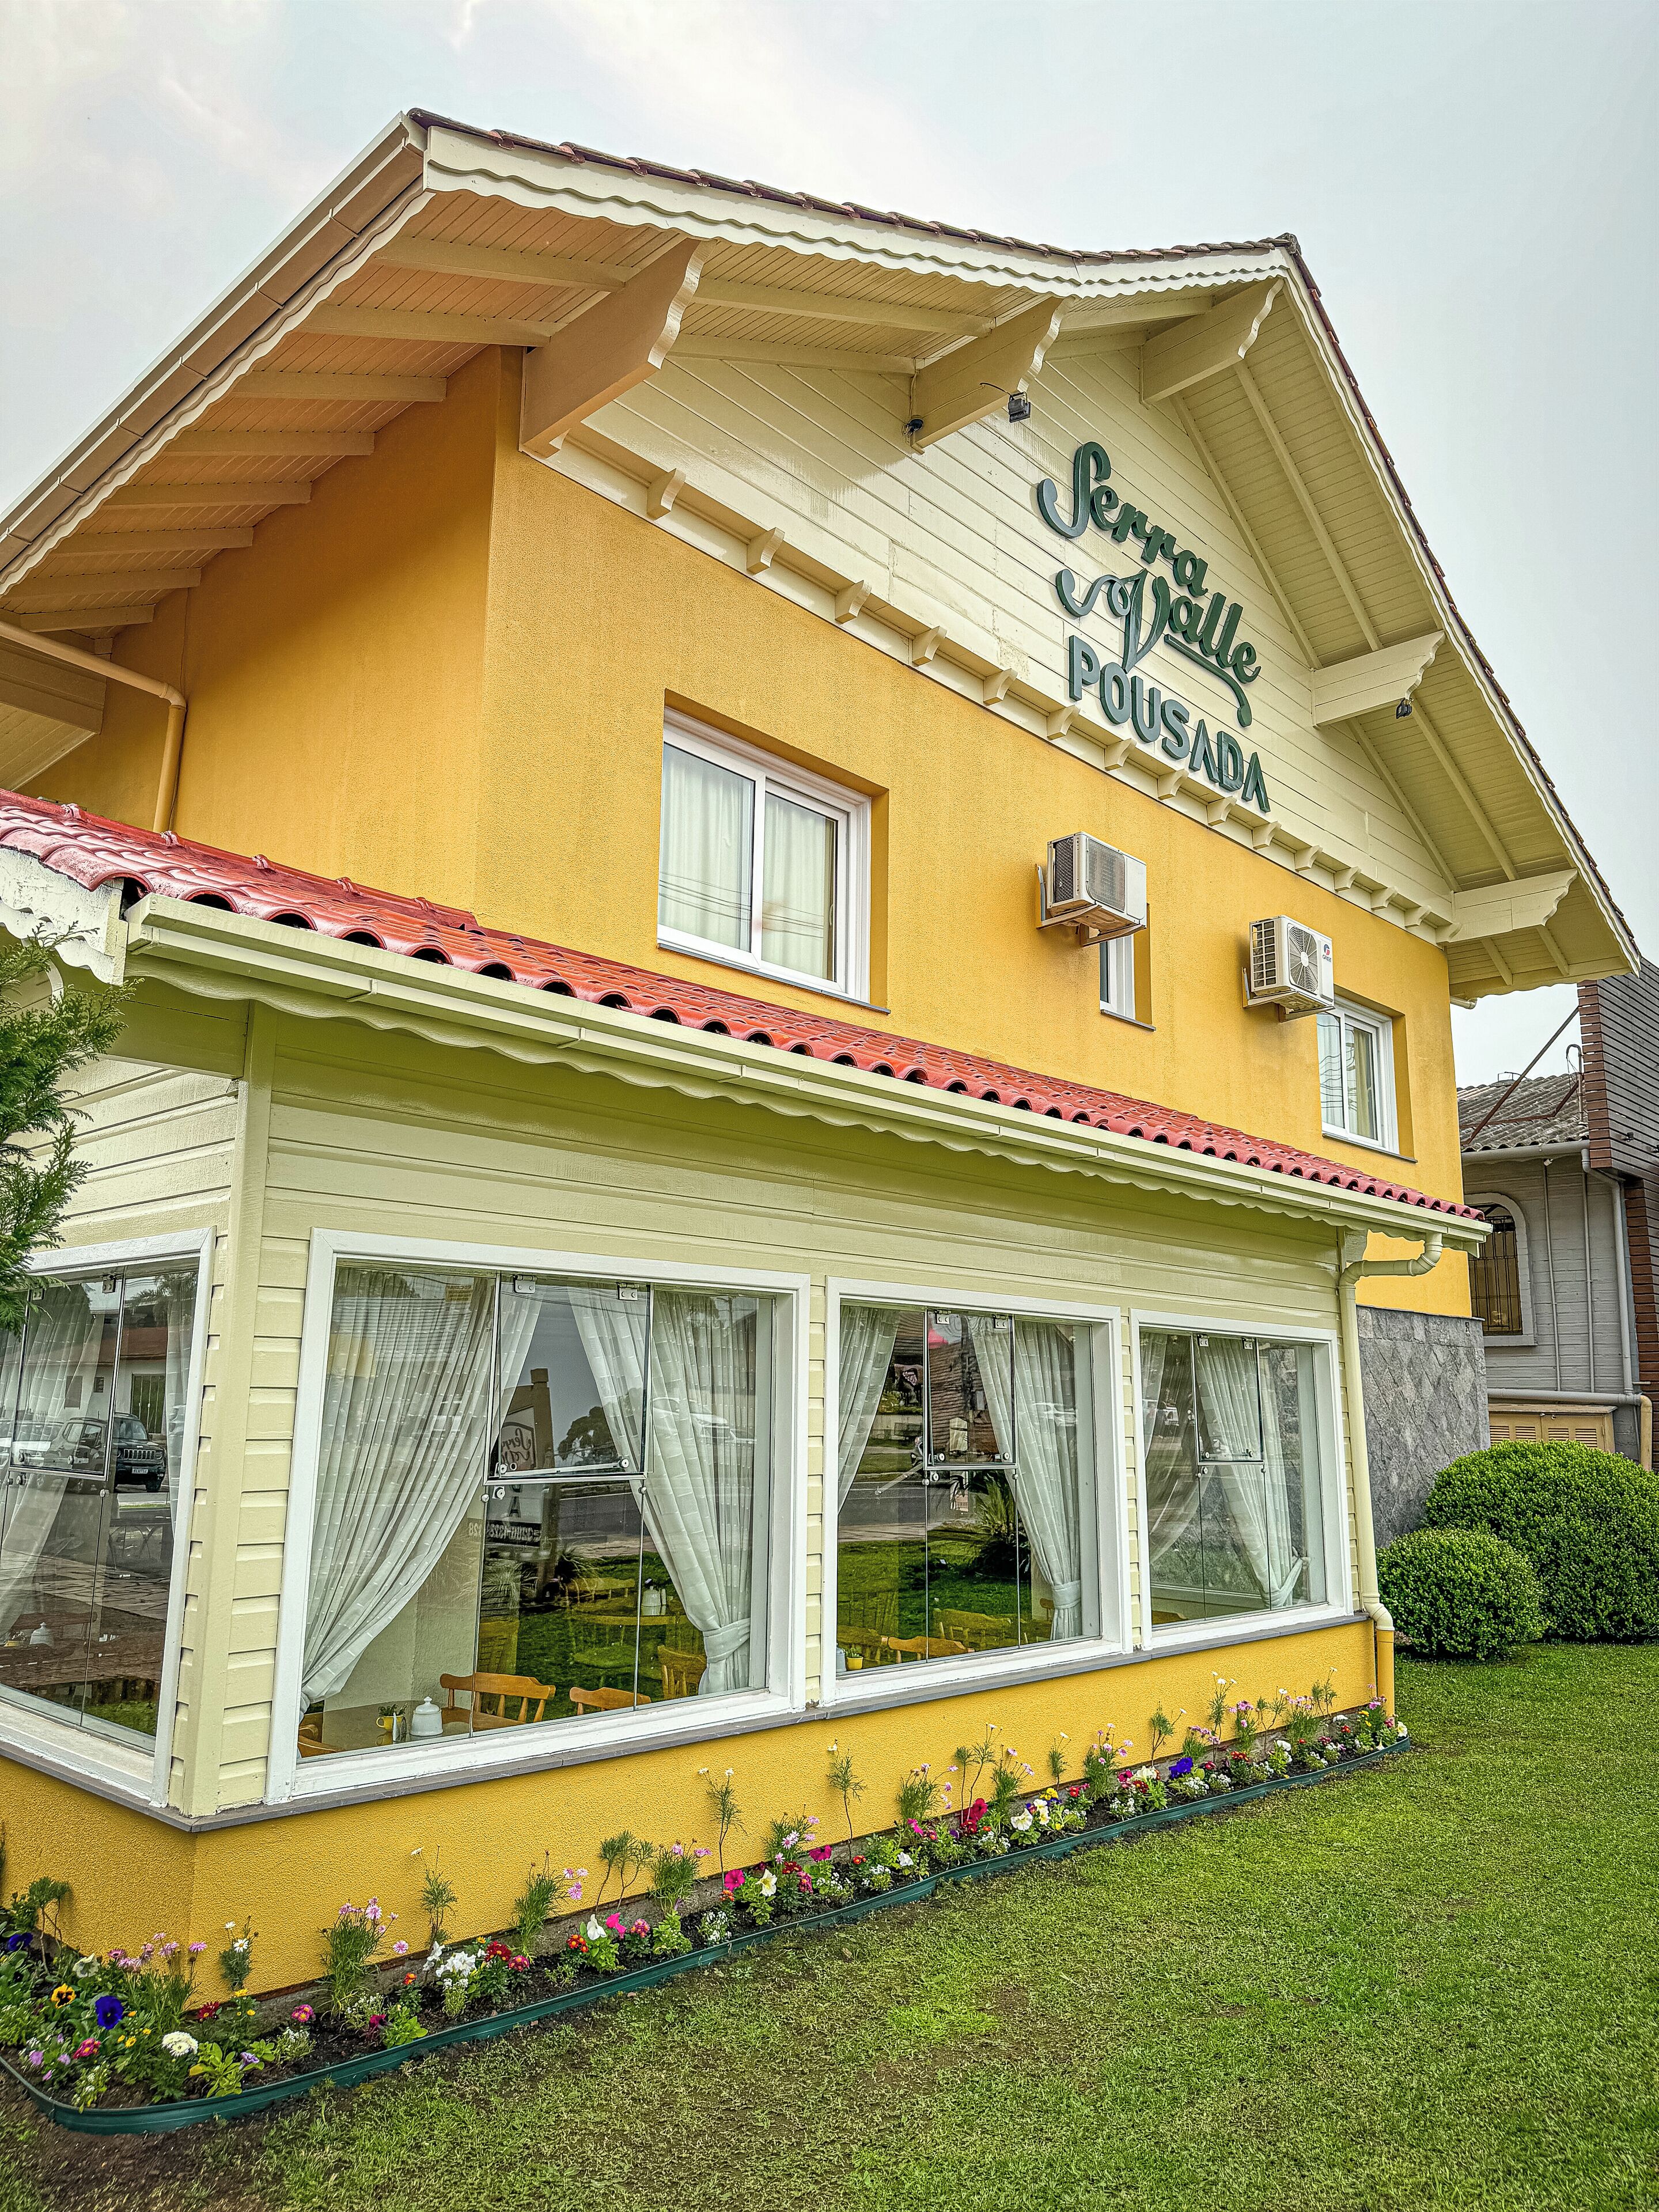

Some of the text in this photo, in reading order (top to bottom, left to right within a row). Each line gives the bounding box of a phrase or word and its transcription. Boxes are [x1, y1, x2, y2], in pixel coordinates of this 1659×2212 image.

[1037, 441, 1209, 597] Serra
[1056, 568, 1262, 685] Valle
[1069, 635, 1271, 813] POUSADA
